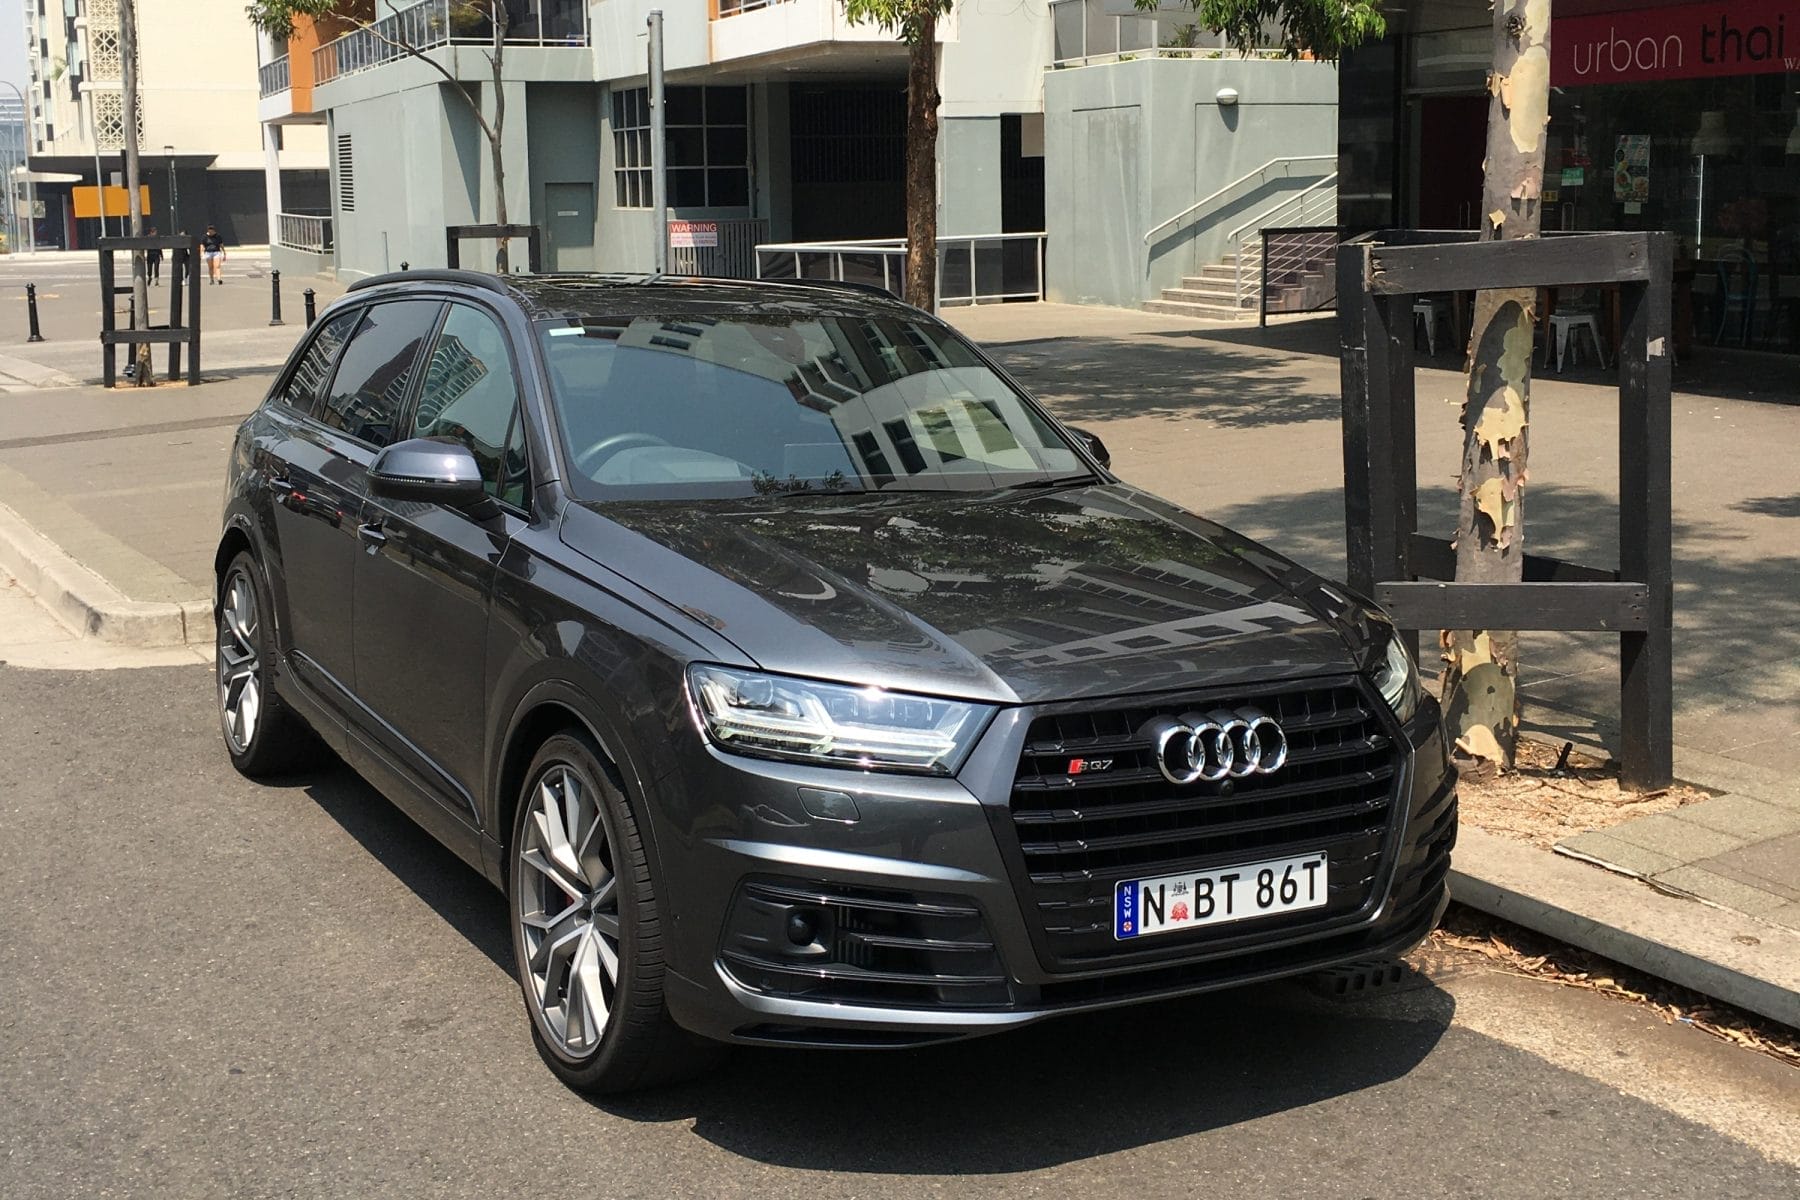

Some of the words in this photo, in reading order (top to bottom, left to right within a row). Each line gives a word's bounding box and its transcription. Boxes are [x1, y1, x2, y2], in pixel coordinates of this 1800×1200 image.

[1574, 26, 1682, 75] urban
[1702, 14, 1784, 63] thai
[671, 223, 717, 232] WARNING
[1123, 885, 1132, 918] NSW
[1256, 860, 1321, 909] 86T
